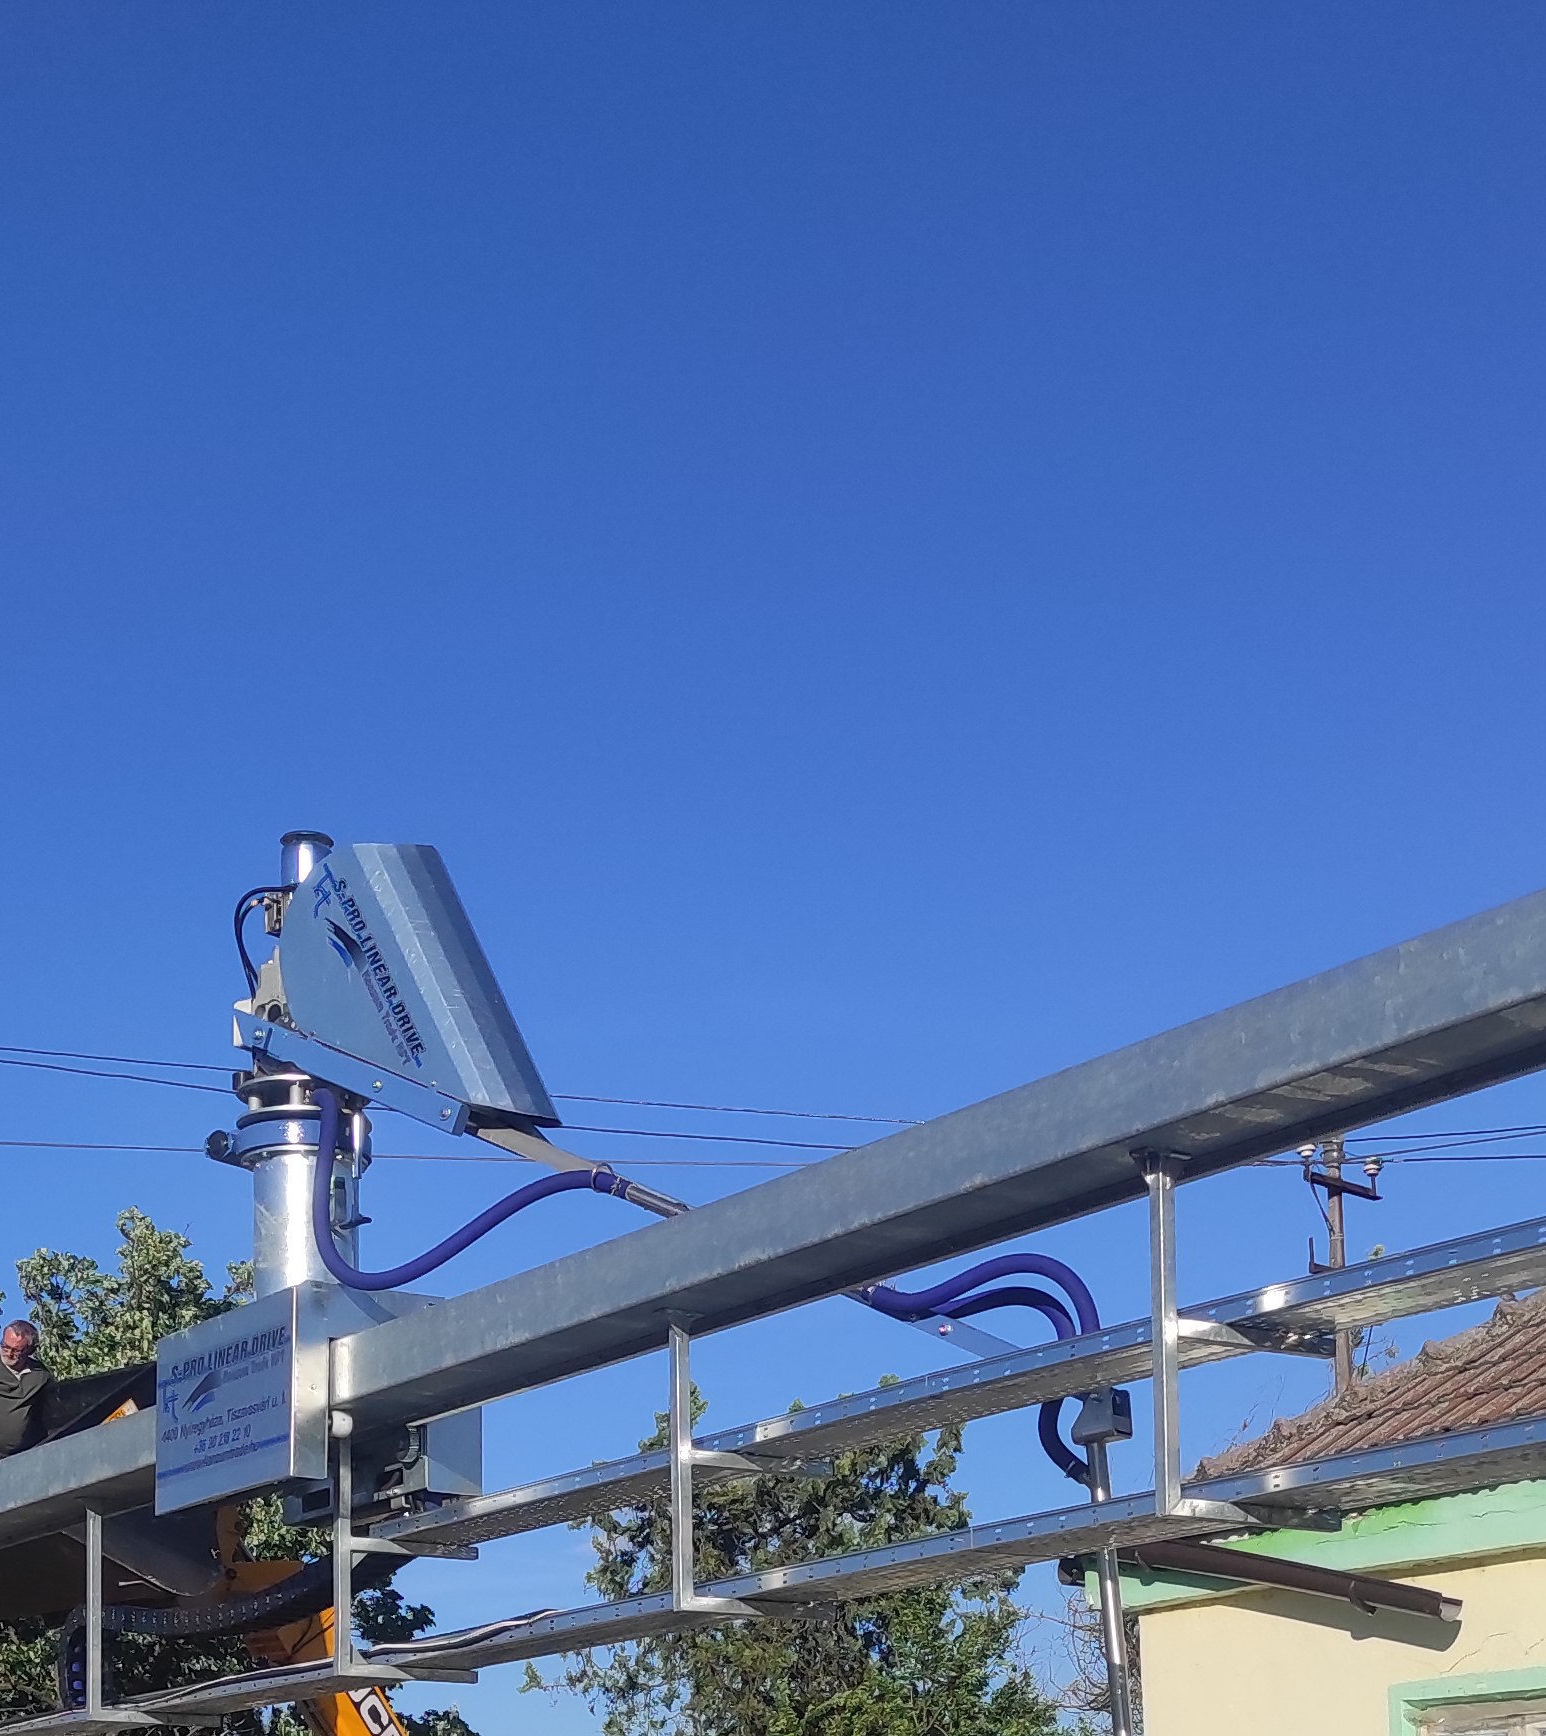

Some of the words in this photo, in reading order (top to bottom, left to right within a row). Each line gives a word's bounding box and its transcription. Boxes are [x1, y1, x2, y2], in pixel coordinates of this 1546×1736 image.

[332, 878, 367, 934] S-PRO
[359, 935, 398, 1001] LINEAR
[392, 1001, 427, 1059] DRIVE
[171, 1356, 205, 1380] S-PRO
[207, 1340, 249, 1371] LINEAR
[252, 1326, 286, 1355] DRIVE
